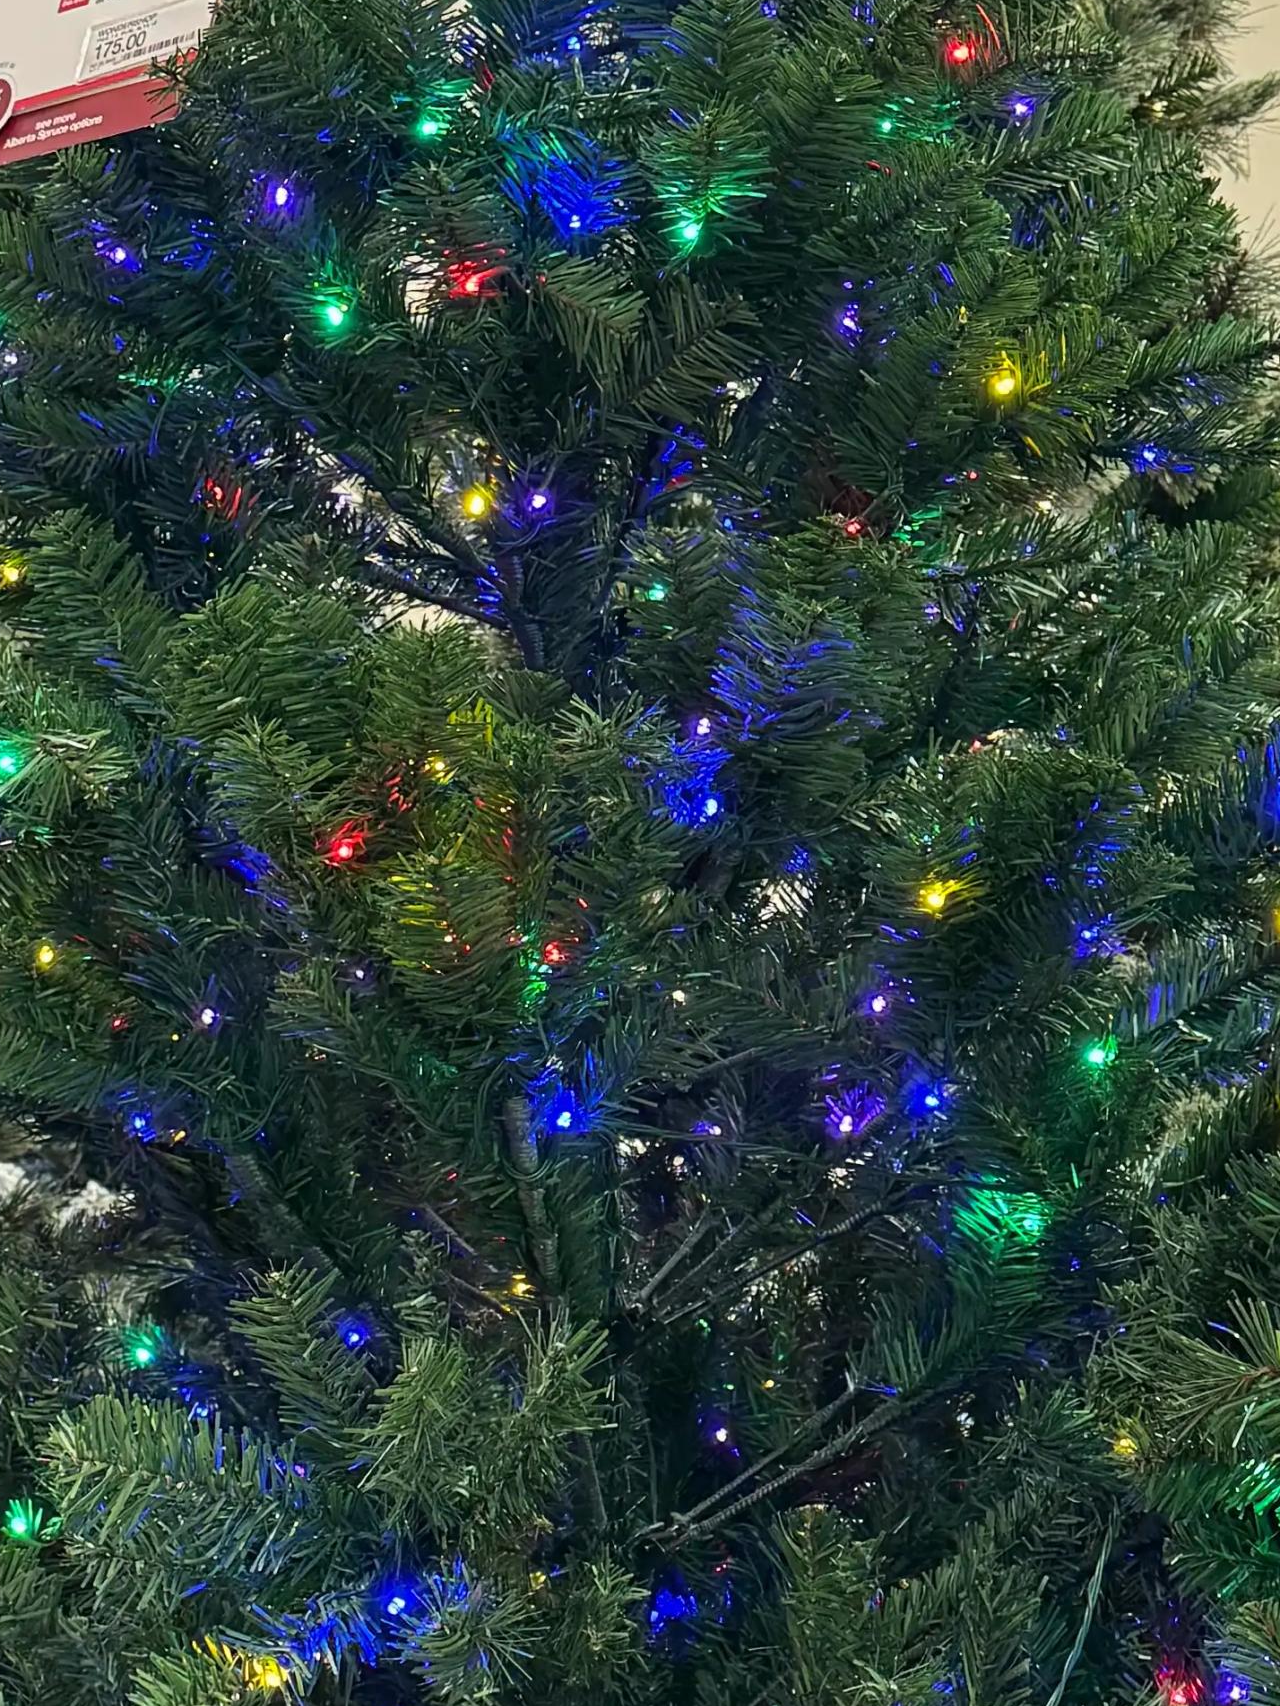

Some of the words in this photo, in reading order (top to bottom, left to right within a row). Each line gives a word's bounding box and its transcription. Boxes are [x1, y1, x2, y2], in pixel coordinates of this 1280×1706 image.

[95, 30, 147, 60] 175.00
[3, 133, 36, 150] Alberta
[36, 126, 69, 141] Spruce
[69, 115, 103, 133] options
[35, 118, 52, 130] see
[53, 112, 77, 125] more
